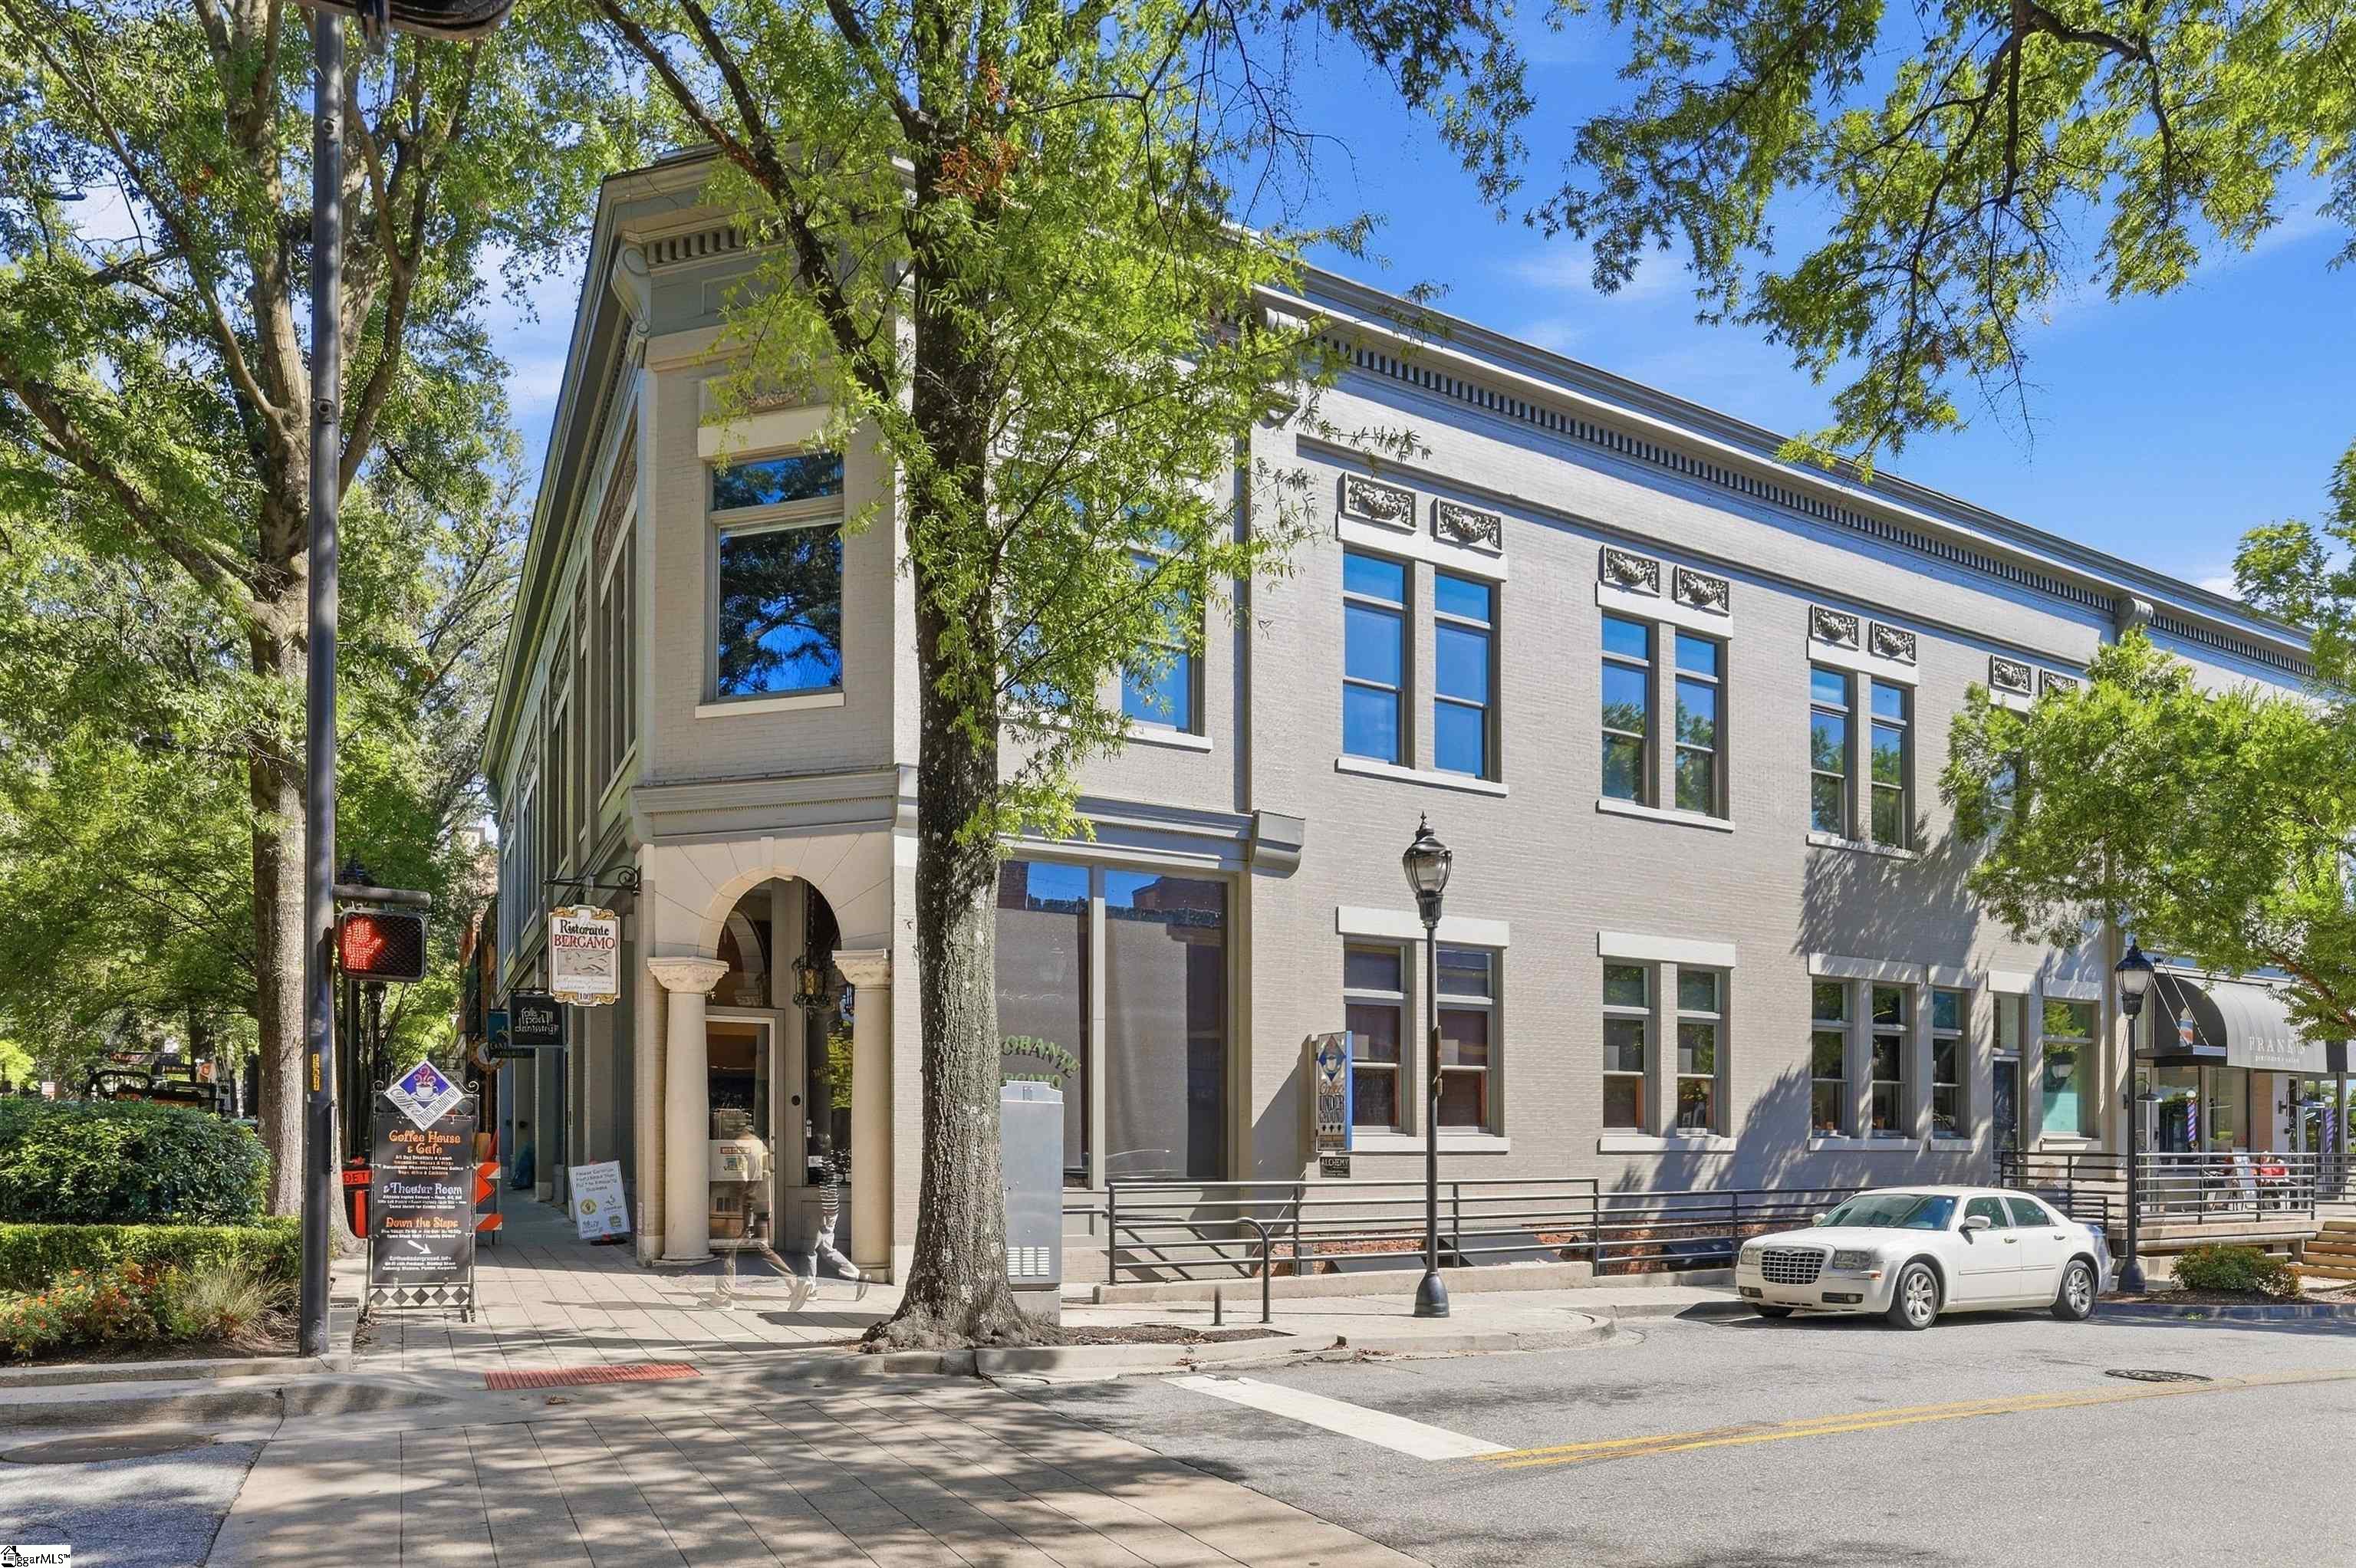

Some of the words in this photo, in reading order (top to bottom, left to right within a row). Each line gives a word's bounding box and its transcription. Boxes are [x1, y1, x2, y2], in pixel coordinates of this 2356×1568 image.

[560, 919, 610, 935] Ristorante
[554, 934, 615, 949] BERGAMO
[389, 1129, 425, 1142] Coffee
[428, 1131, 461, 1143] House
[390, 1182, 433, 1194] Theater
[435, 1183, 462, 1195] Room
[386, 1217, 413, 1228] Down
[416, 1216, 431, 1228] the
[433, 1216, 459, 1229] Steps
